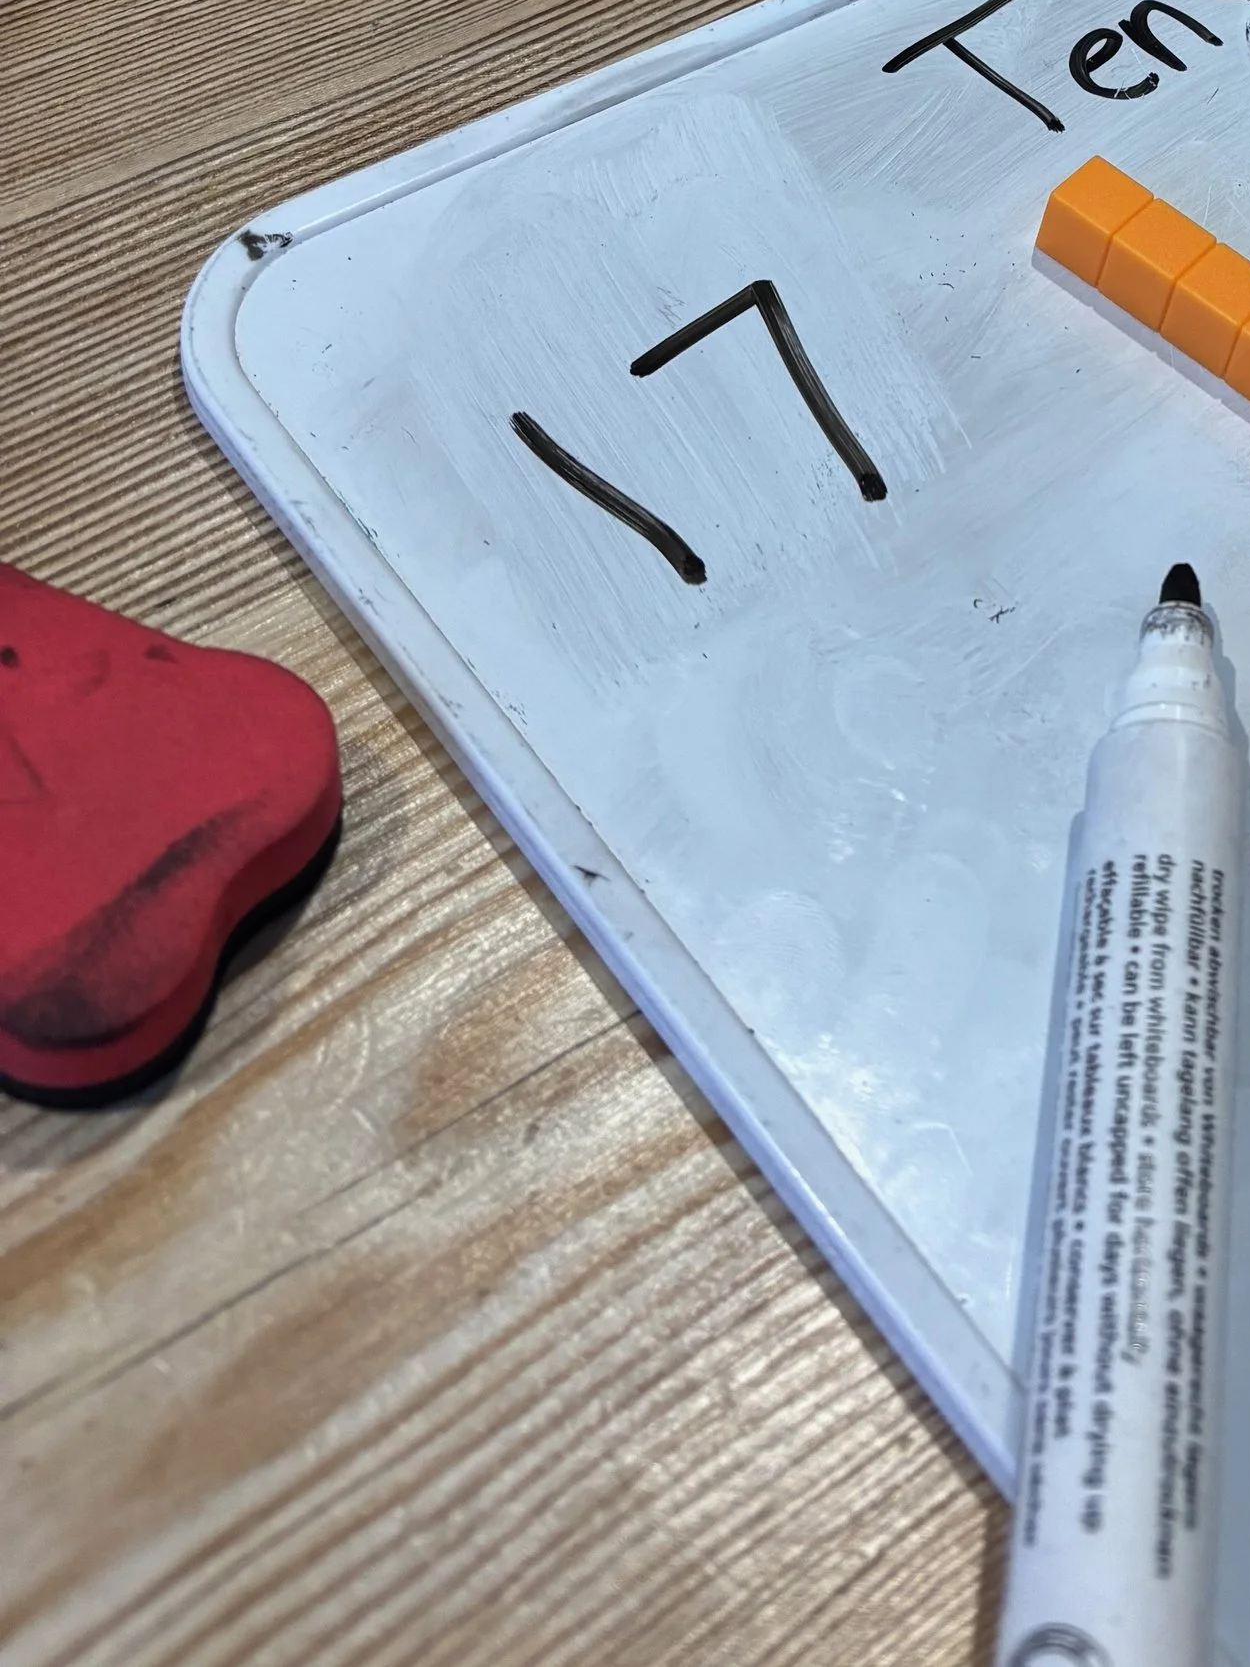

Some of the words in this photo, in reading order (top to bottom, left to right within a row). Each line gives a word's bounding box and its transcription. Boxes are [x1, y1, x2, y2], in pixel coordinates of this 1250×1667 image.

[508, 278, 888, 586] 17
[1127, 854, 1149, 938] refillable
[1154, 854, 1176, 884] dry
[1093, 861, 1117, 948] effaçable
[1152, 890, 1170, 936] wipe
[1186, 859, 1208, 969] nachfüllbar
[1210, 869, 1225, 941] trocken
[1123, 961, 1141, 995] can
[1150, 943, 1171, 989] from
[1088, 1007, 1103, 1036] sur
[1121, 1002, 1141, 1025] be
[1183, 992, 1202, 1042] kann
[1204, 946, 1222, 1060] abwischbar
[1117, 1033, 1138, 1069] left
[1140, 997, 1166, 1127] whiteboards
[1079, 1042, 1101, 1138] tableaux
[1174, 1050, 1198, 1145] tagelang
[1202, 1068, 1215, 1105] von
[1109, 1075, 1132, 1184] uncapped
[1108, 1192, 1129, 1223] for
[1174, 1151, 1194, 1215] offen
[1099, 1232, 1125, 1287] days
[1095, 1292, 1120, 1394] without
[1166, 1309, 1185, 1375] ohne
[1082, 1401, 1115, 1489] drying
[1081, 1495, 1104, 1534] up
